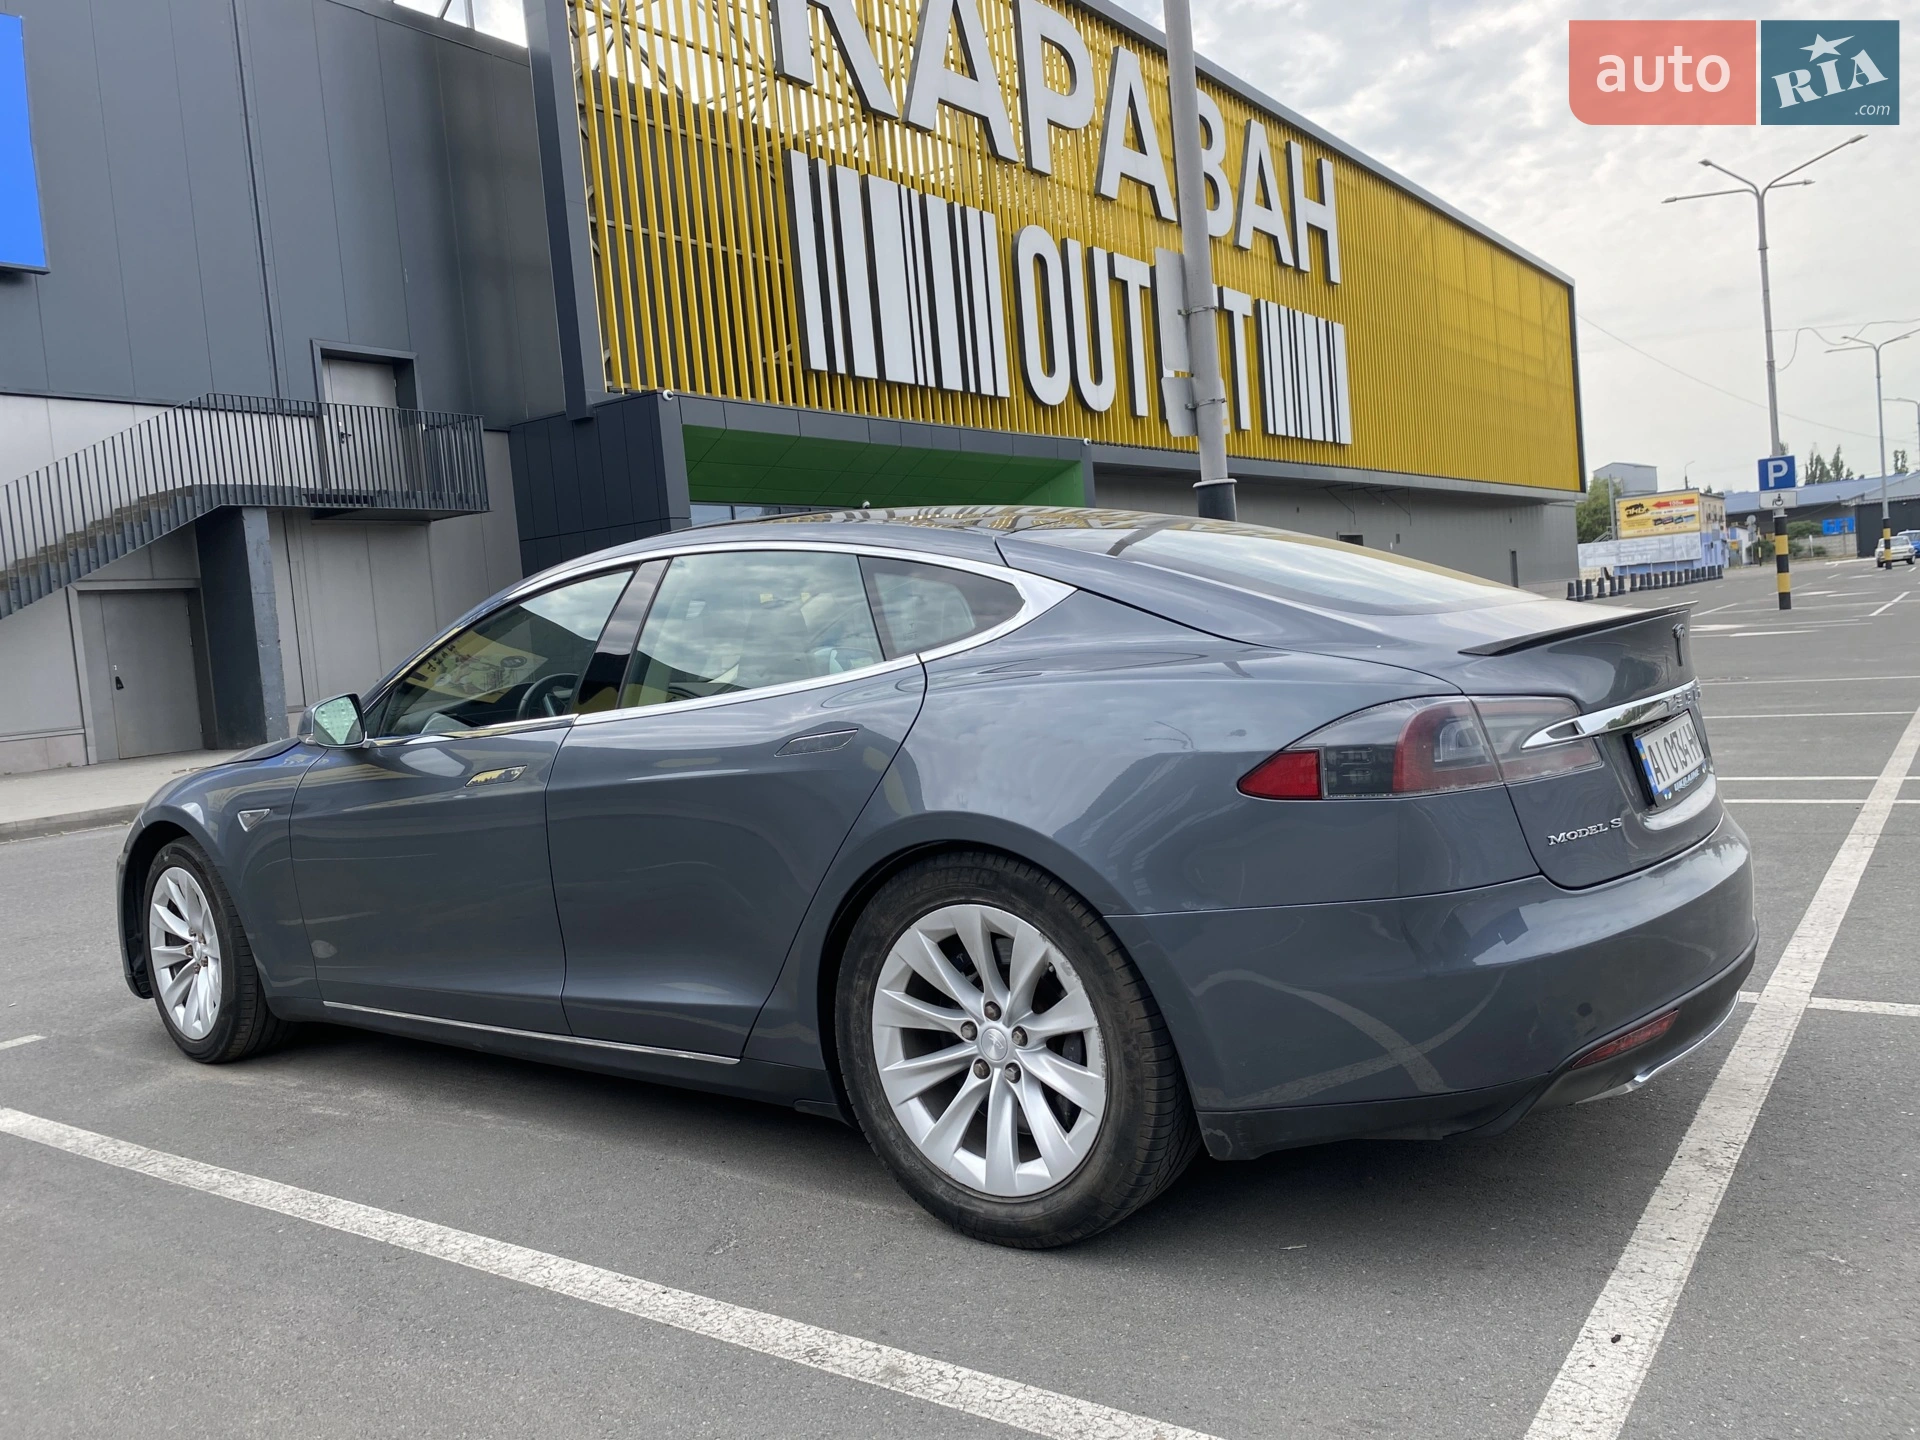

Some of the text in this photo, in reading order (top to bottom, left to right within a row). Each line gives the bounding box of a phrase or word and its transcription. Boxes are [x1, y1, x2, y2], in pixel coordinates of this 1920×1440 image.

[1012, 225, 1253, 433] OUTT
[1768, 459, 1788, 487] P
[1647, 741, 1670, 785] AI
[1663, 727, 1693, 774] 0134
[1547, 817, 1622, 846] MODEL S
